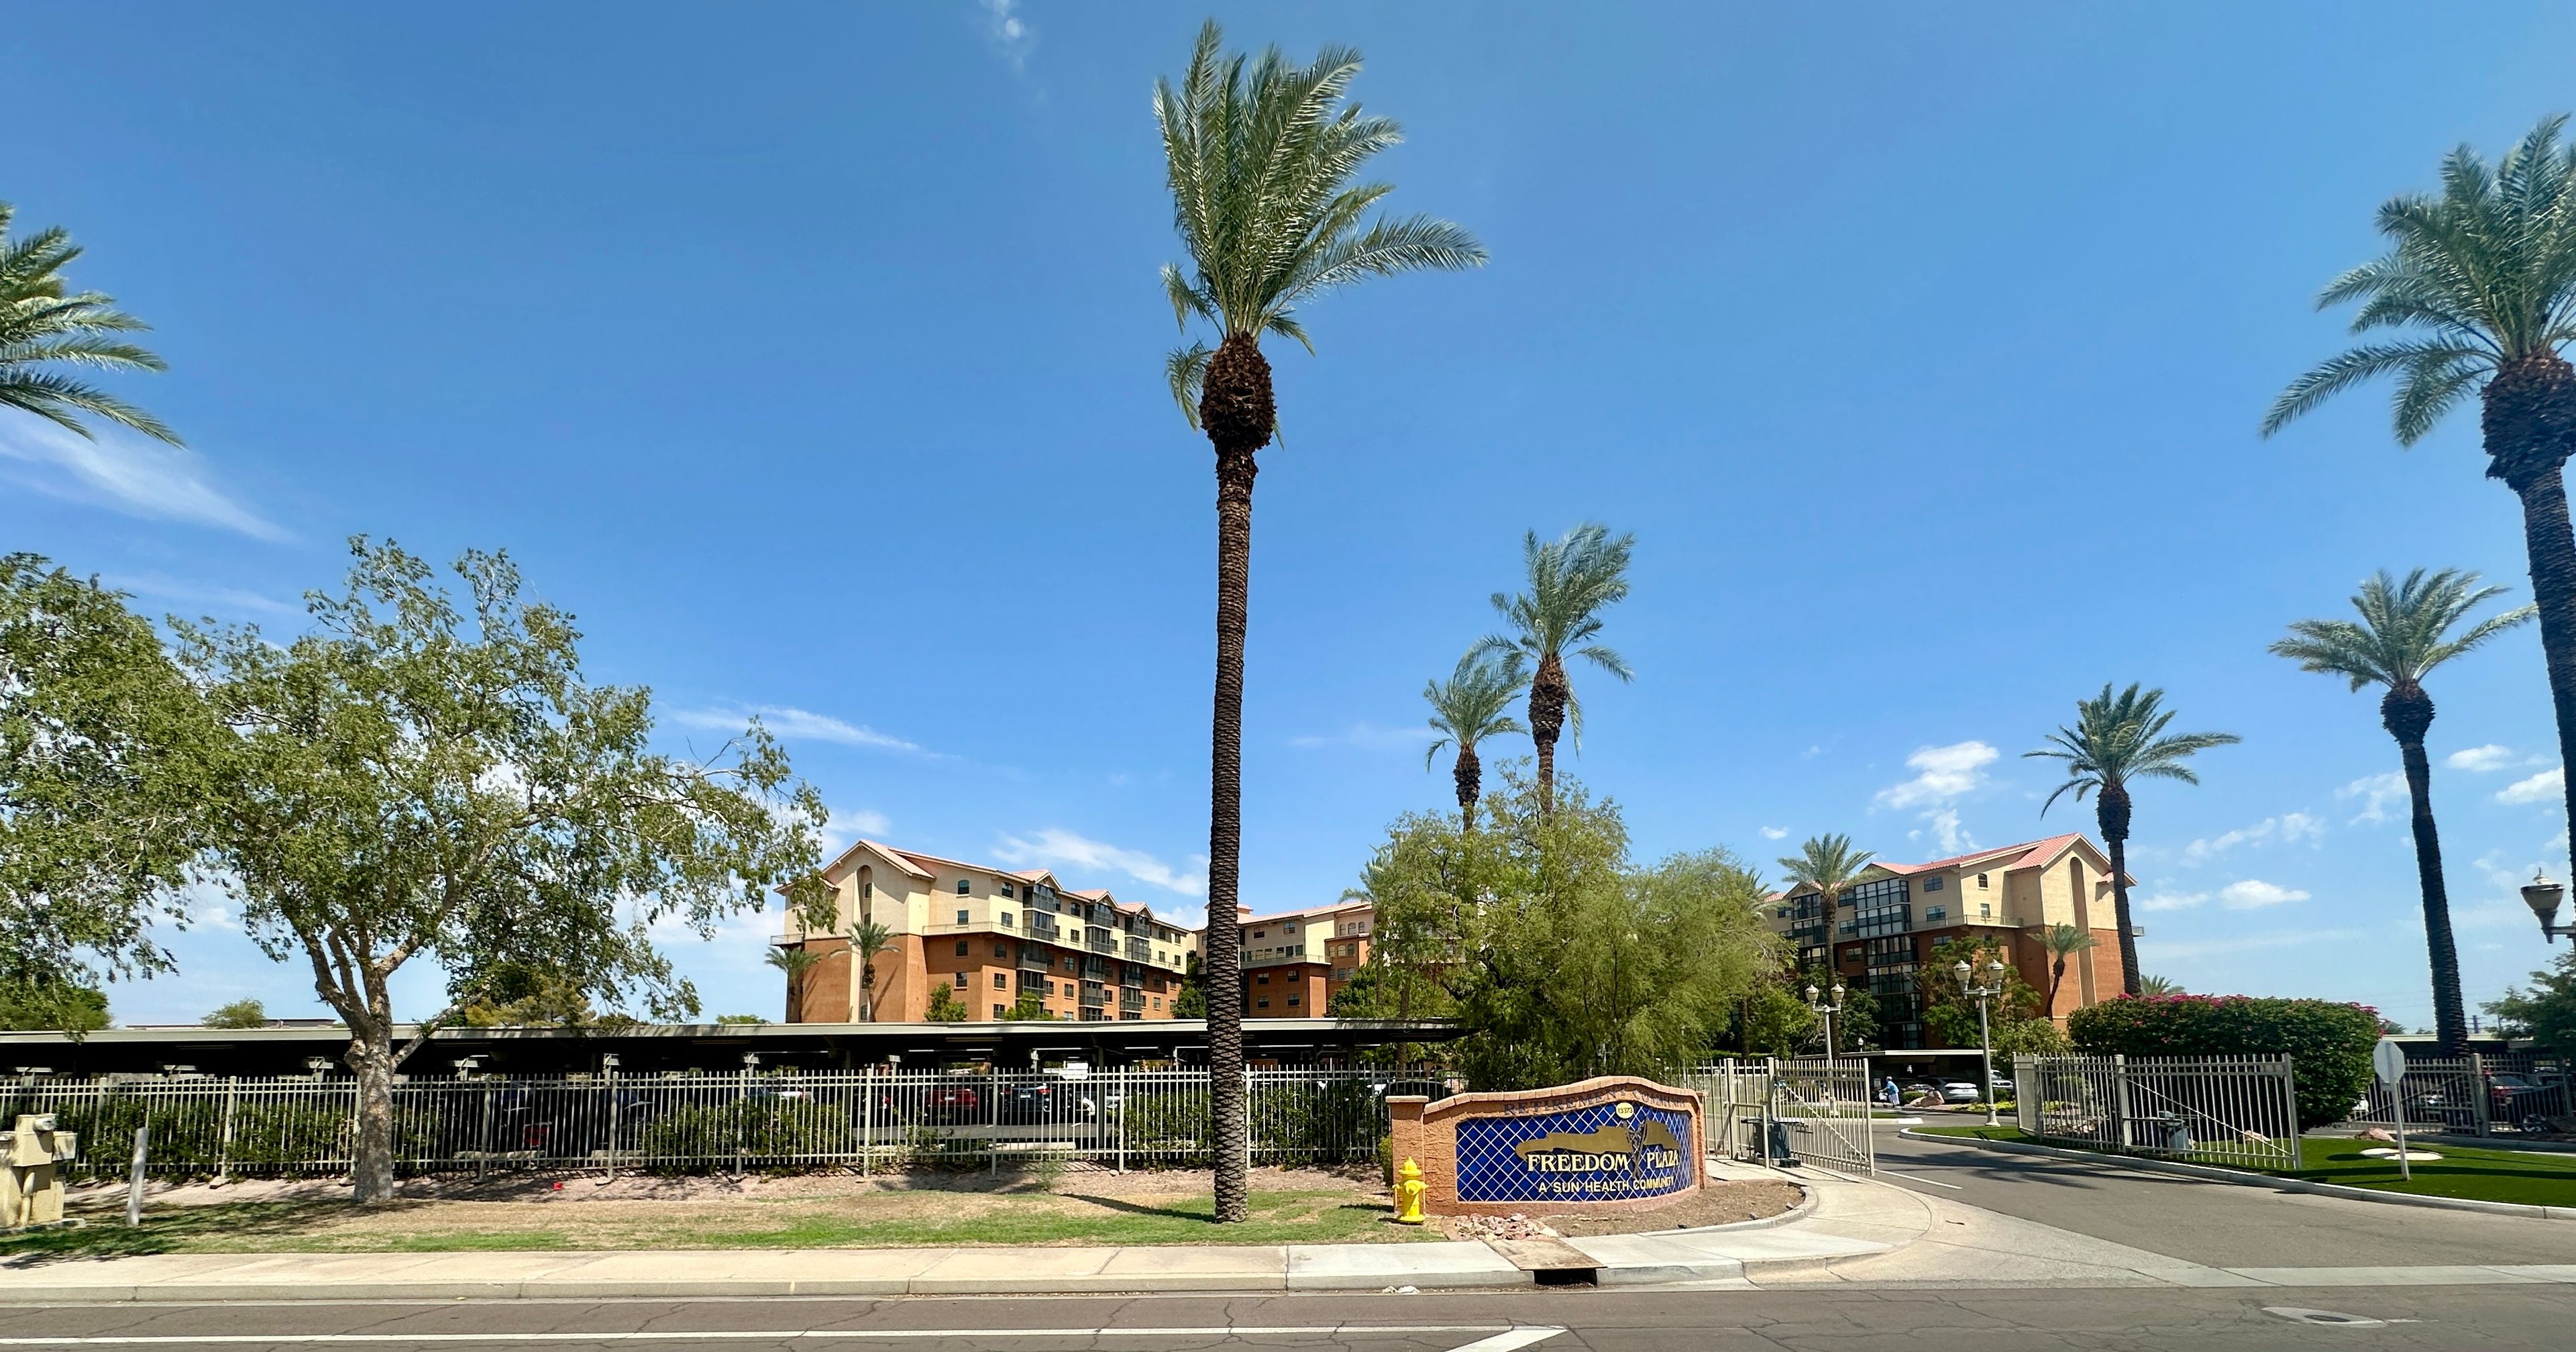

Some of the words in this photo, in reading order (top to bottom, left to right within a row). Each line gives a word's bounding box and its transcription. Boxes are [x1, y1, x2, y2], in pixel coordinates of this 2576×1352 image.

[1503, 1084, 1628, 1114] RETIREMENT
[1527, 1153, 1629, 1172] FREEDOM
[1646, 1149, 1679, 1169] PLAZA
[1538, 1182, 1548, 1193] A
[1553, 1182, 1580, 1192] SUN
[1585, 1181, 1629, 1192] HEALTH
[1633, 1176, 1674, 1190] COMMUNITY
